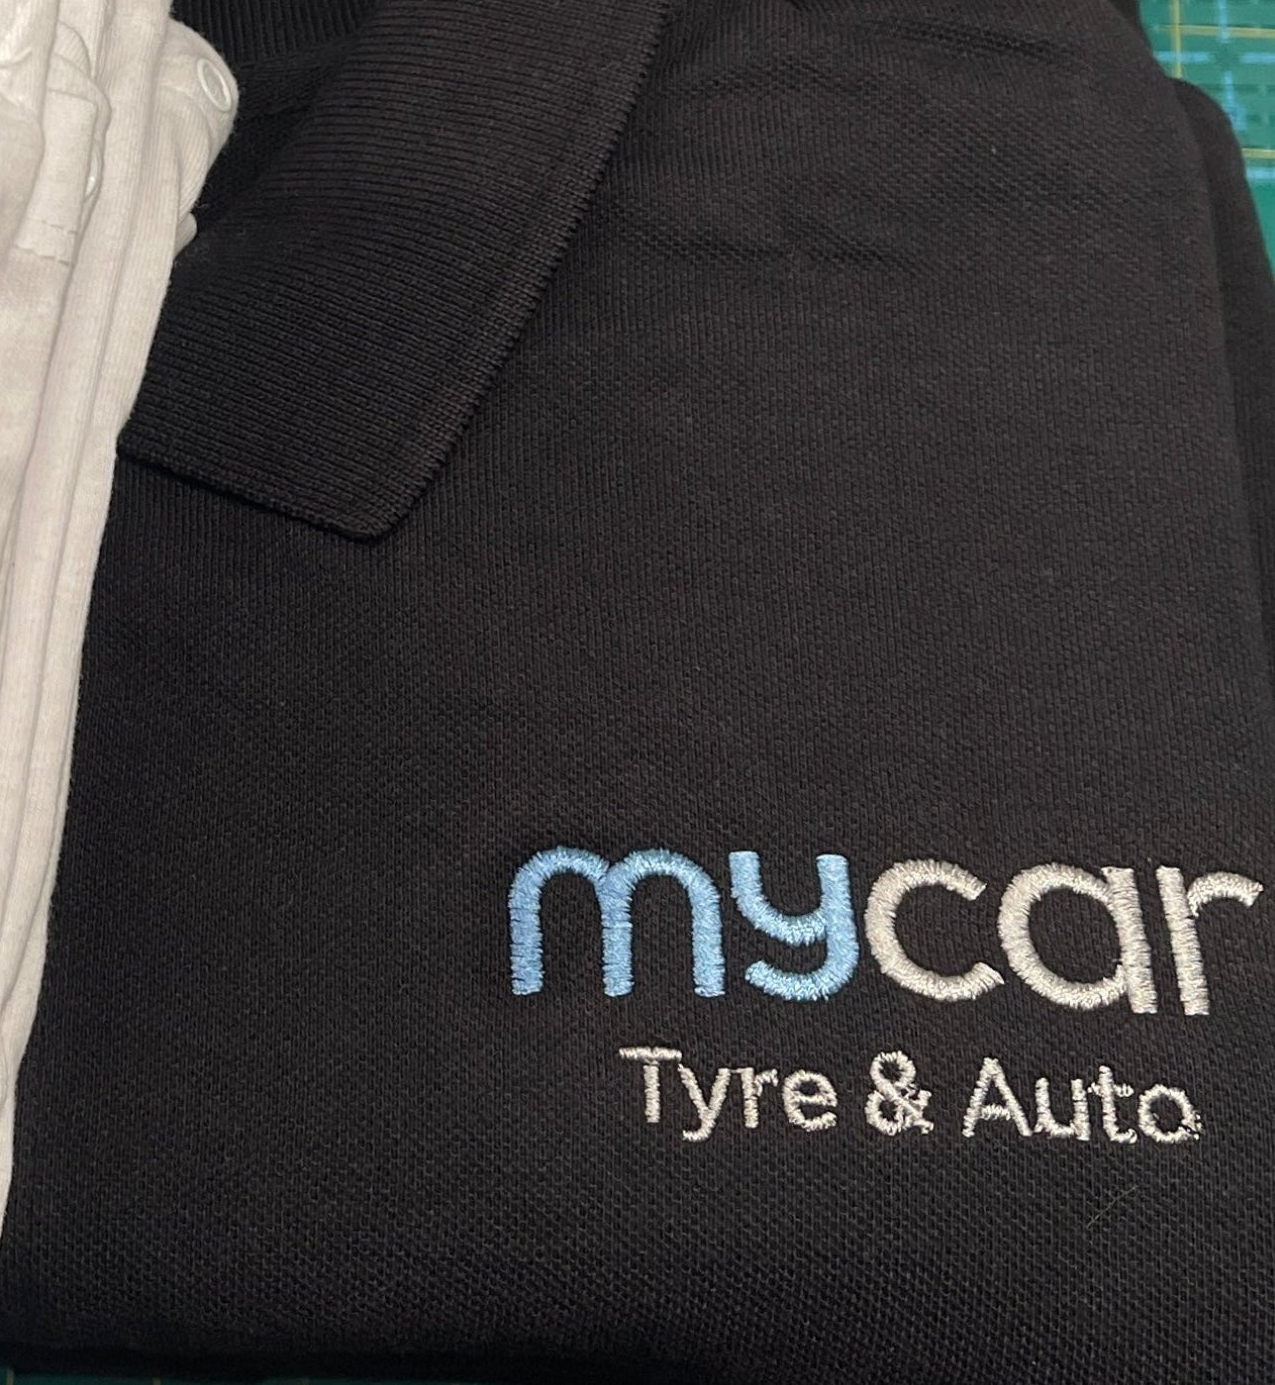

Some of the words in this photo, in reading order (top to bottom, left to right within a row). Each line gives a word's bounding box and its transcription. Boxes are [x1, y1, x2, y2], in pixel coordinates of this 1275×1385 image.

[508, 845, 1264, 1016] mycar
[618, 1045, 837, 1143] Tyre
[864, 1050, 934, 1137] &
[961, 1057, 1203, 1145] Auto
